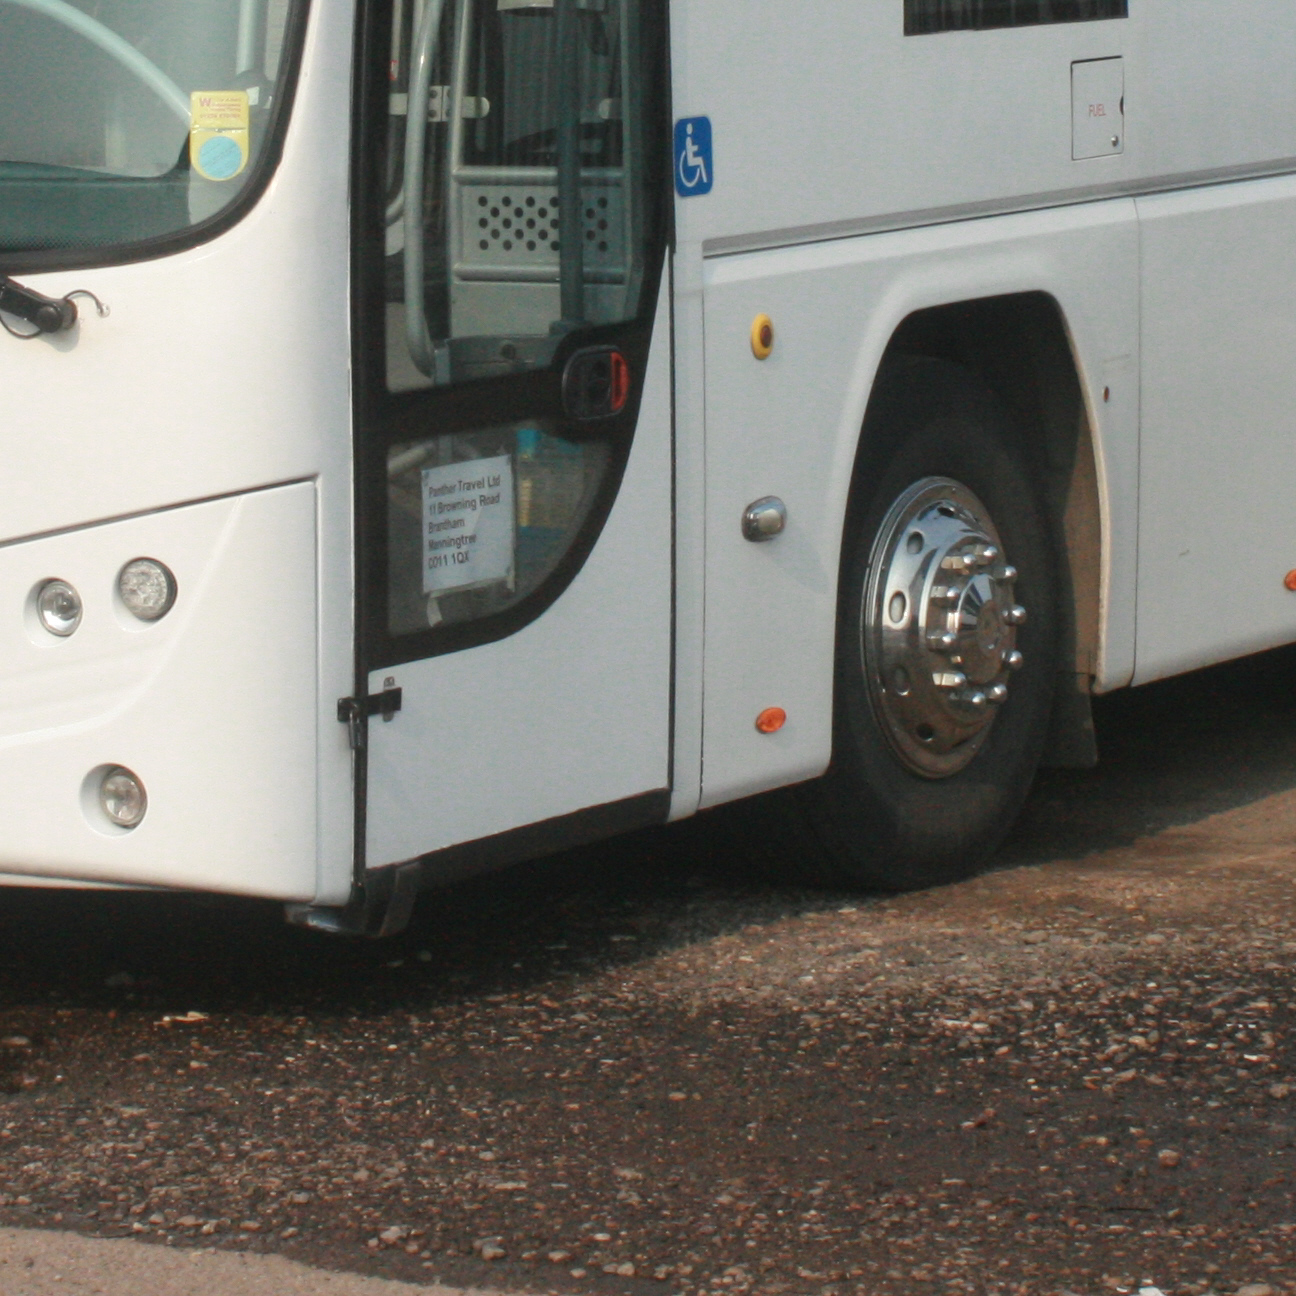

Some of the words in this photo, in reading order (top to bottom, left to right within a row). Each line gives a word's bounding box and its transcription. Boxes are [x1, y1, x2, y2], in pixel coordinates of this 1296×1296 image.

[458, 477, 485, 492] Travel
[487, 475, 501, 488] Ltd
[437, 499, 477, 515] Browning
[479, 493, 501, 507] Road
[452, 551, 469, 565] 1QX
